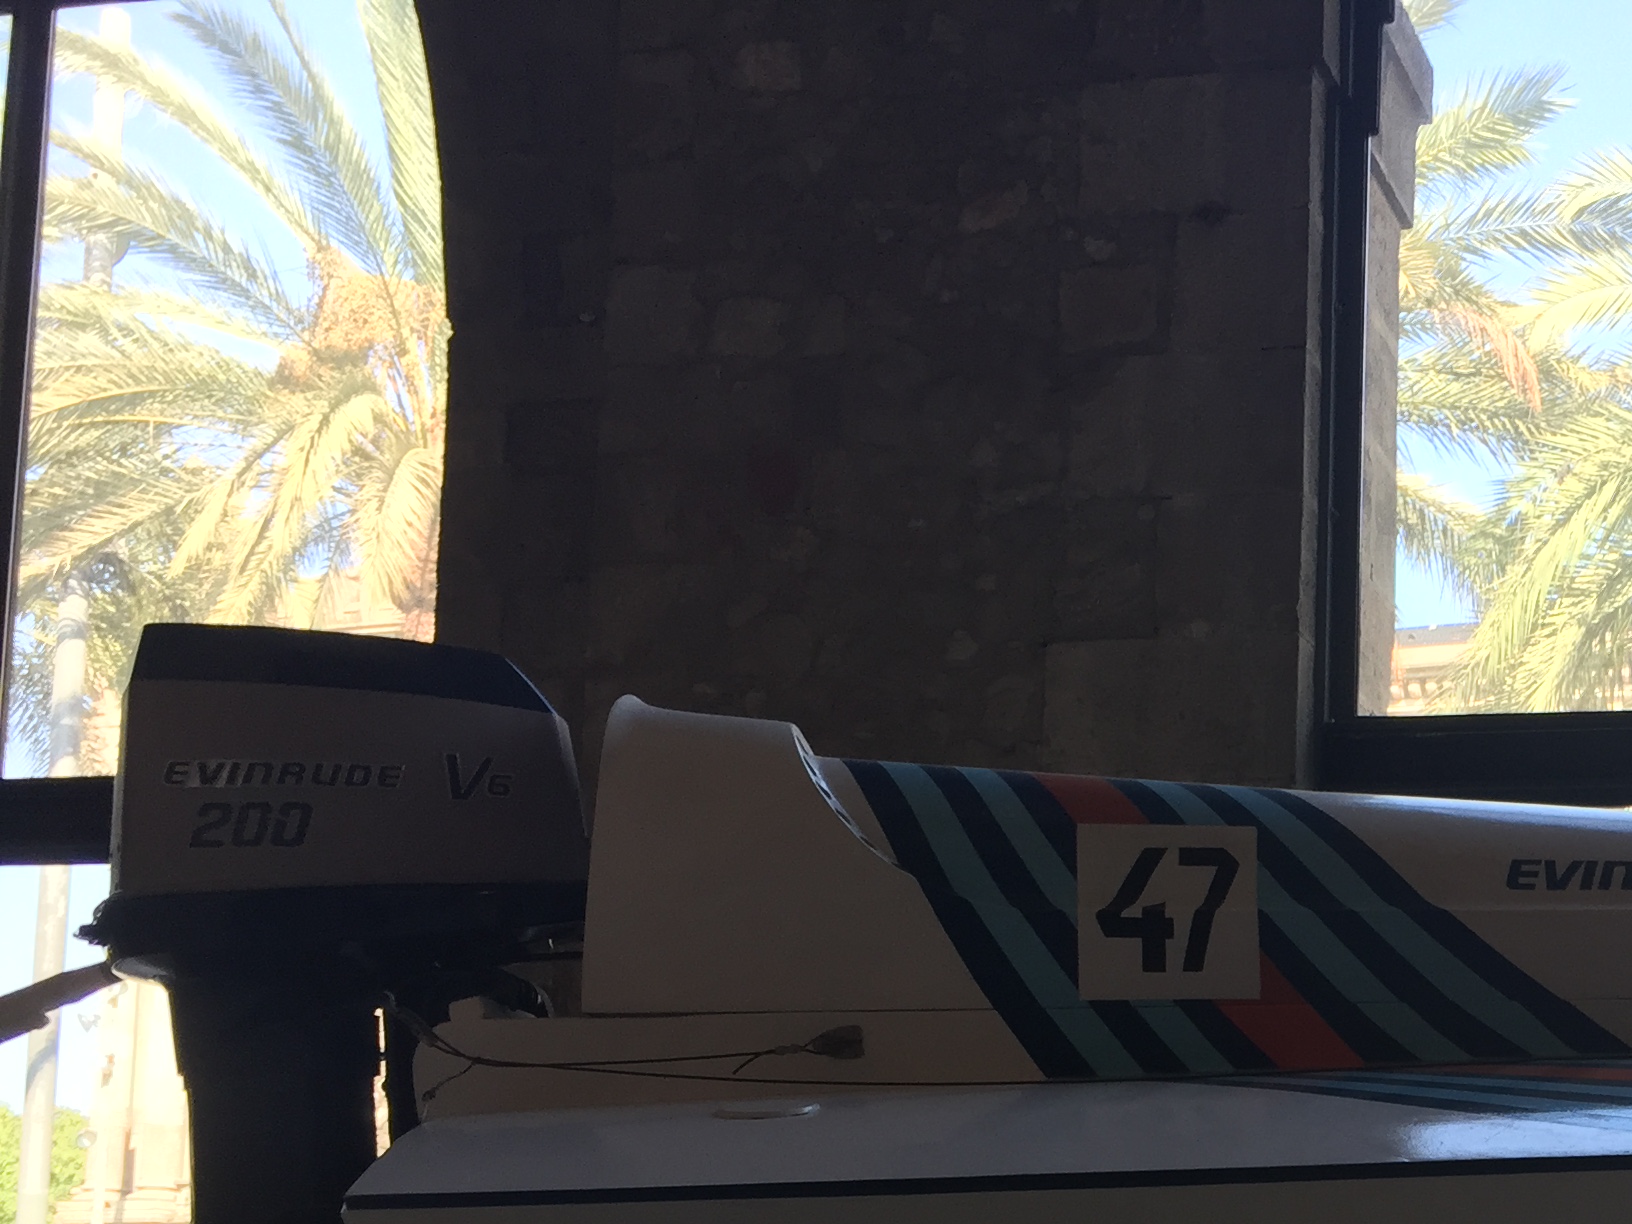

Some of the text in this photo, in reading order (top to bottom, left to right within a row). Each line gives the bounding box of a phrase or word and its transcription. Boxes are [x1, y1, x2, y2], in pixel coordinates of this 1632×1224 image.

[163, 760, 403, 788] EVINRUDE
[445, 752, 514, 800] V6
[189, 800, 315, 849] 200
[1096, 847, 1240, 973] 47
